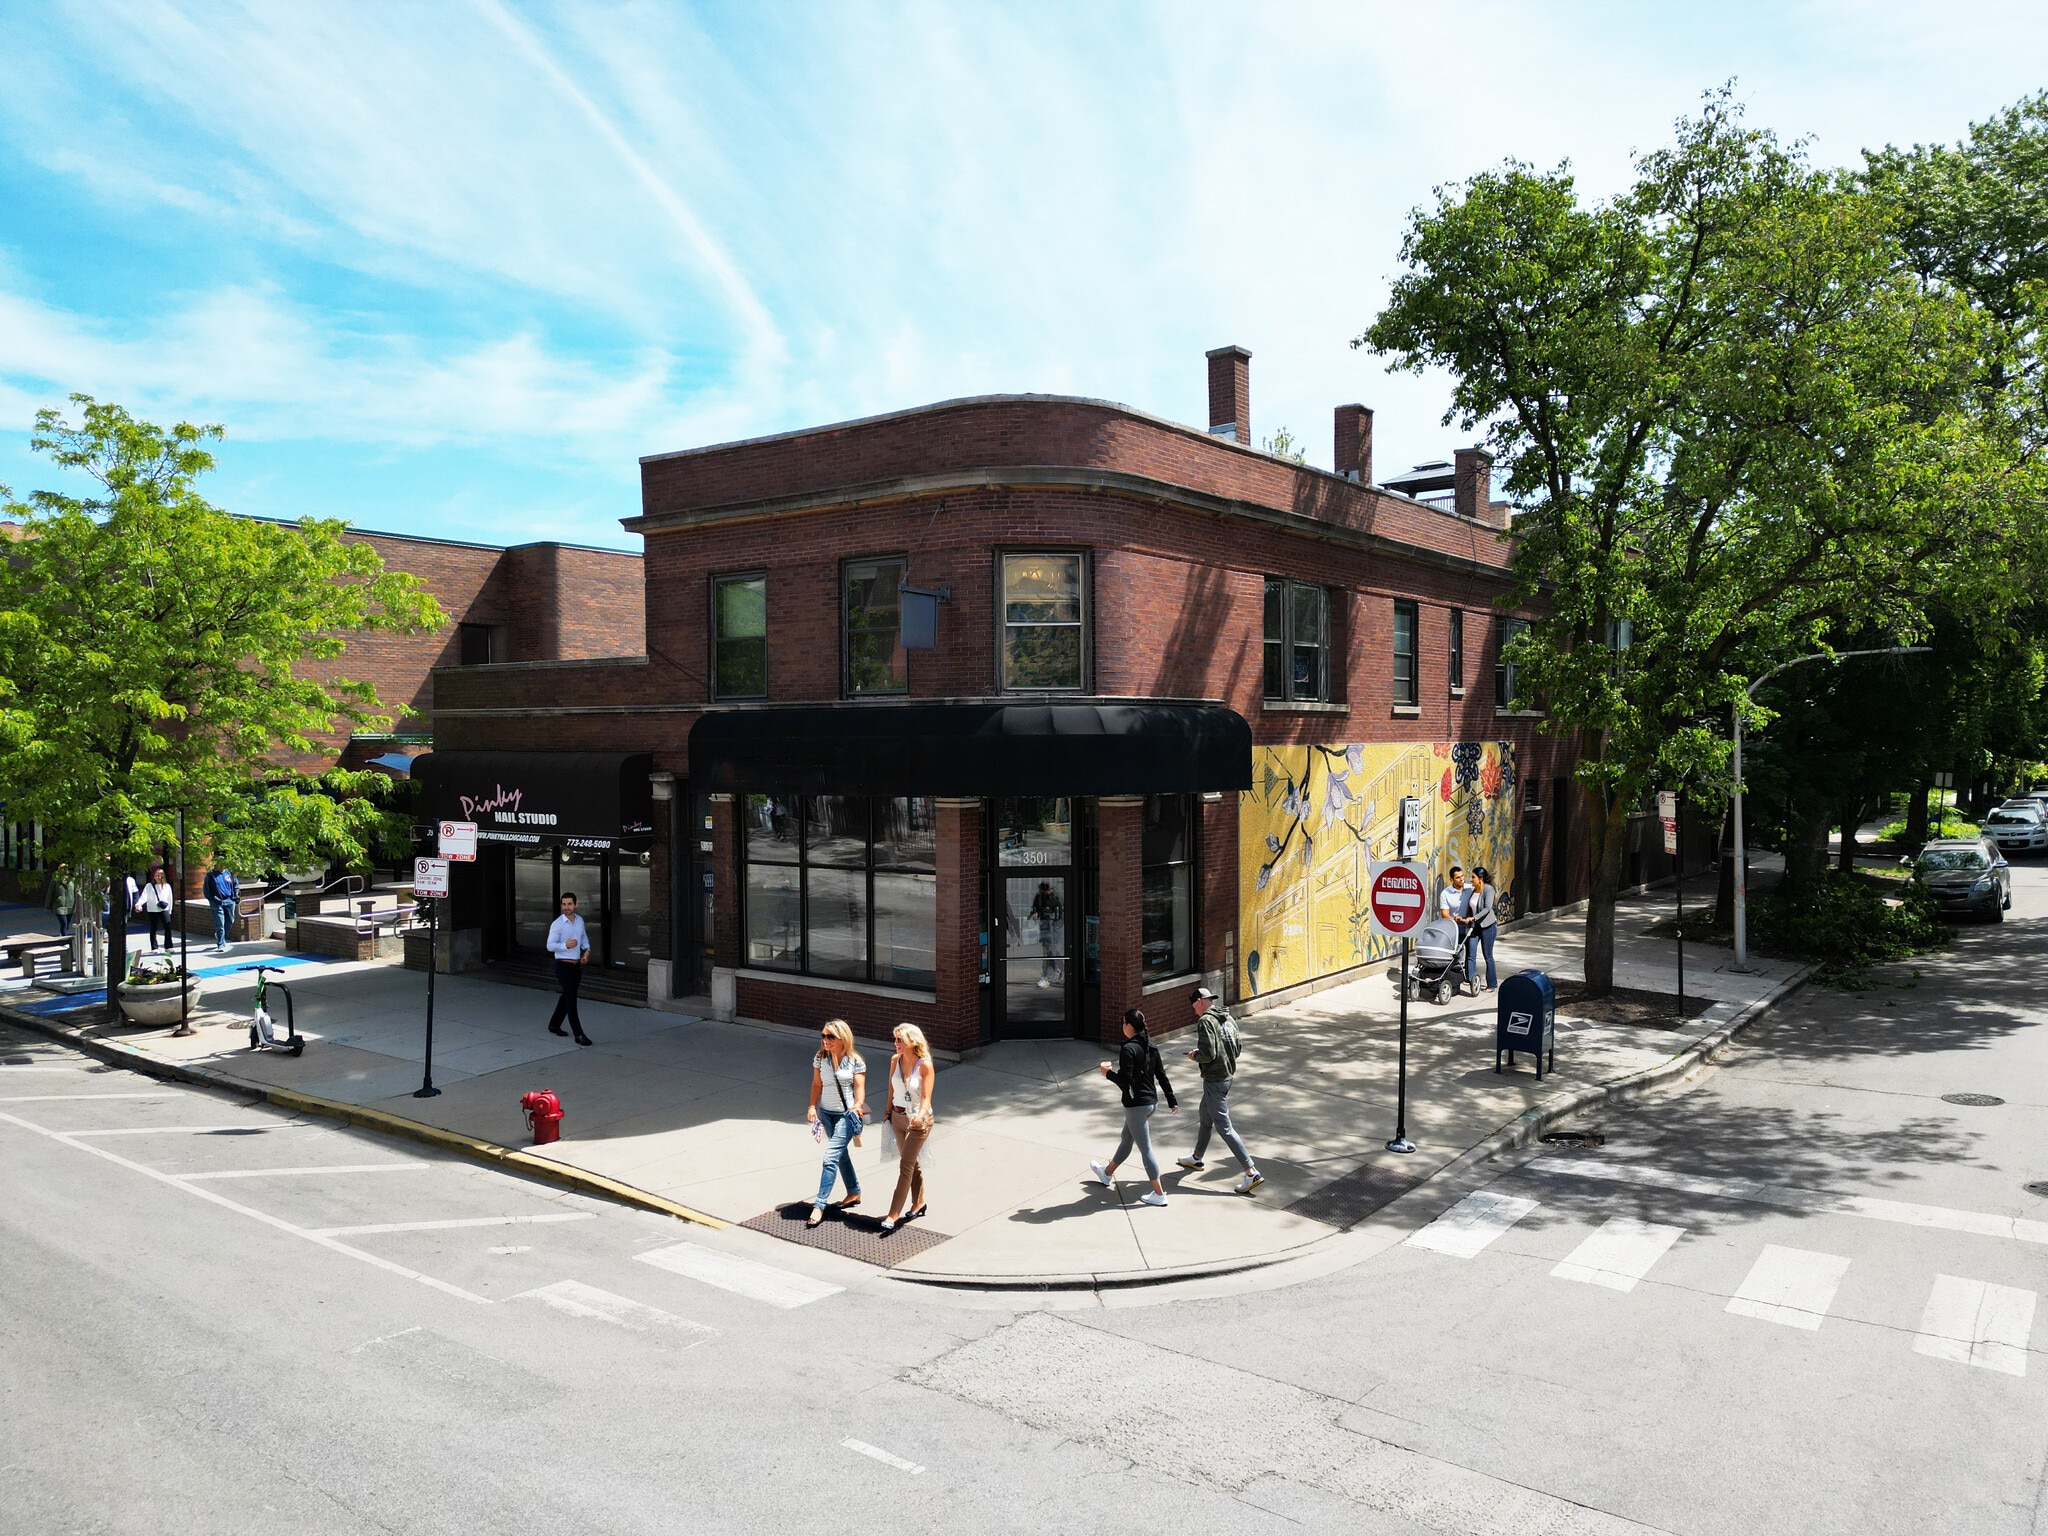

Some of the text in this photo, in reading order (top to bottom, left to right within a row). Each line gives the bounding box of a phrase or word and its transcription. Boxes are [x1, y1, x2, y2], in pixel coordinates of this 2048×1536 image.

[460, 784, 522, 821] Pinky
[1407, 803, 1418, 817] ONE
[495, 811, 558, 825] NAIL STUDIO
[1407, 820, 1418, 833] WAY
[1023, 852, 1047, 864] 3501
